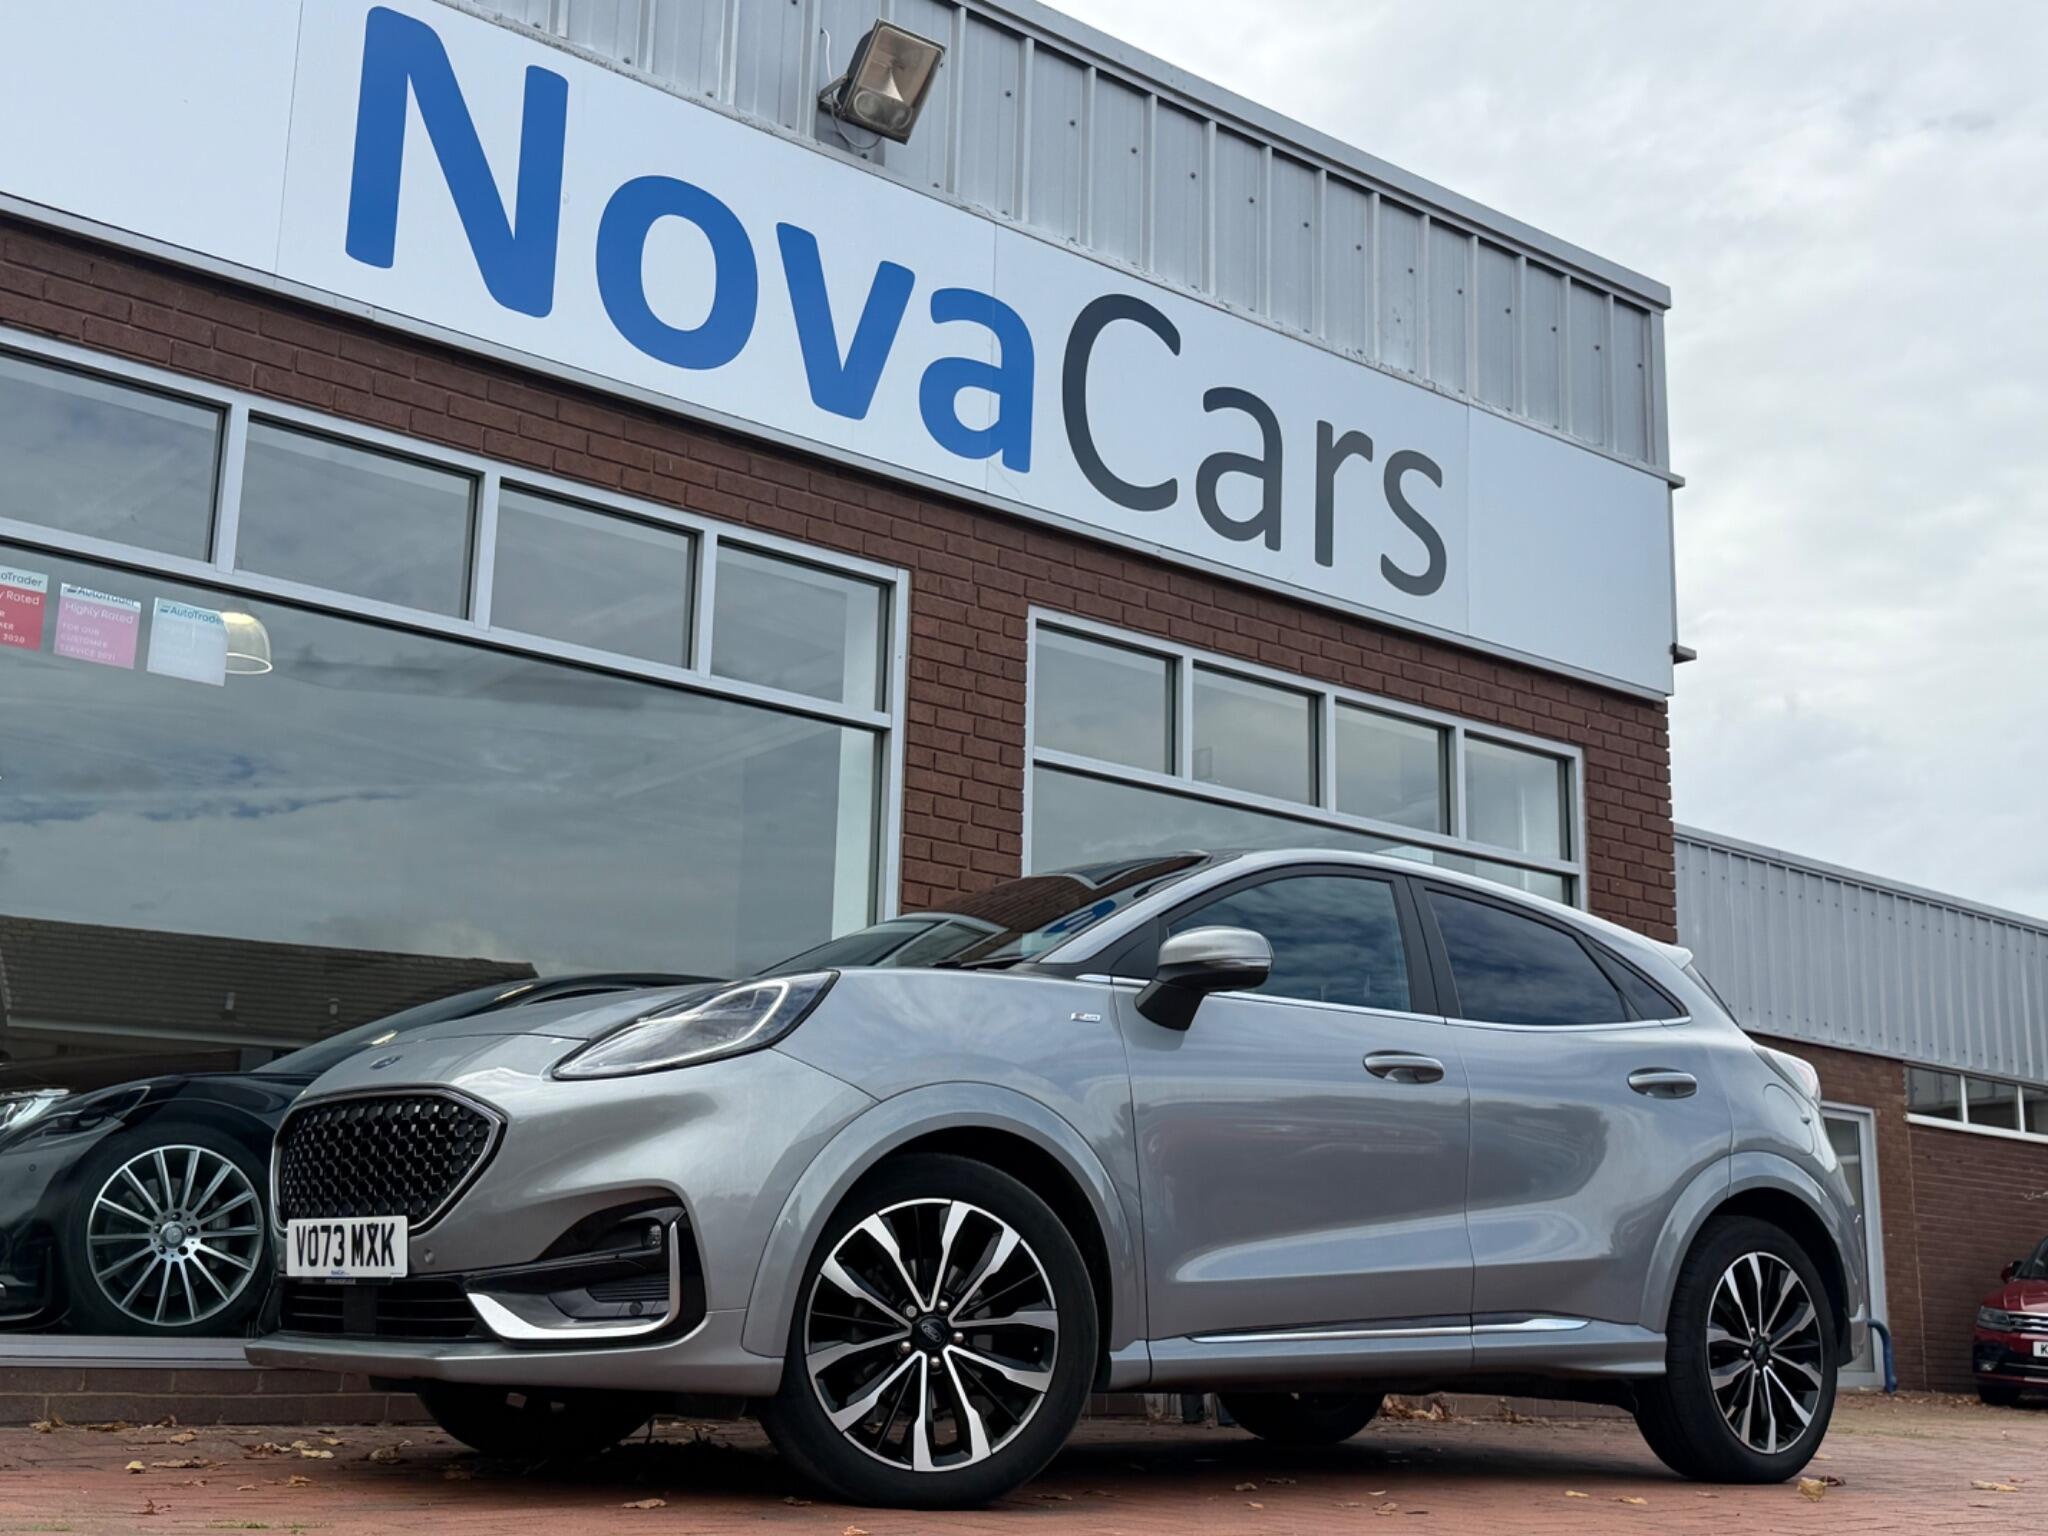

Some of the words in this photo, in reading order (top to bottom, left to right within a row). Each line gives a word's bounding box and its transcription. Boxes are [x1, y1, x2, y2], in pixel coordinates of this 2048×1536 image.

[345, 6, 1447, 597] NovaCars
[7, 590, 40, 606] Rated
[65, 601, 98, 618] Highly
[101, 608, 133, 624] Rated
[352, 1222, 395, 1267] MXK
